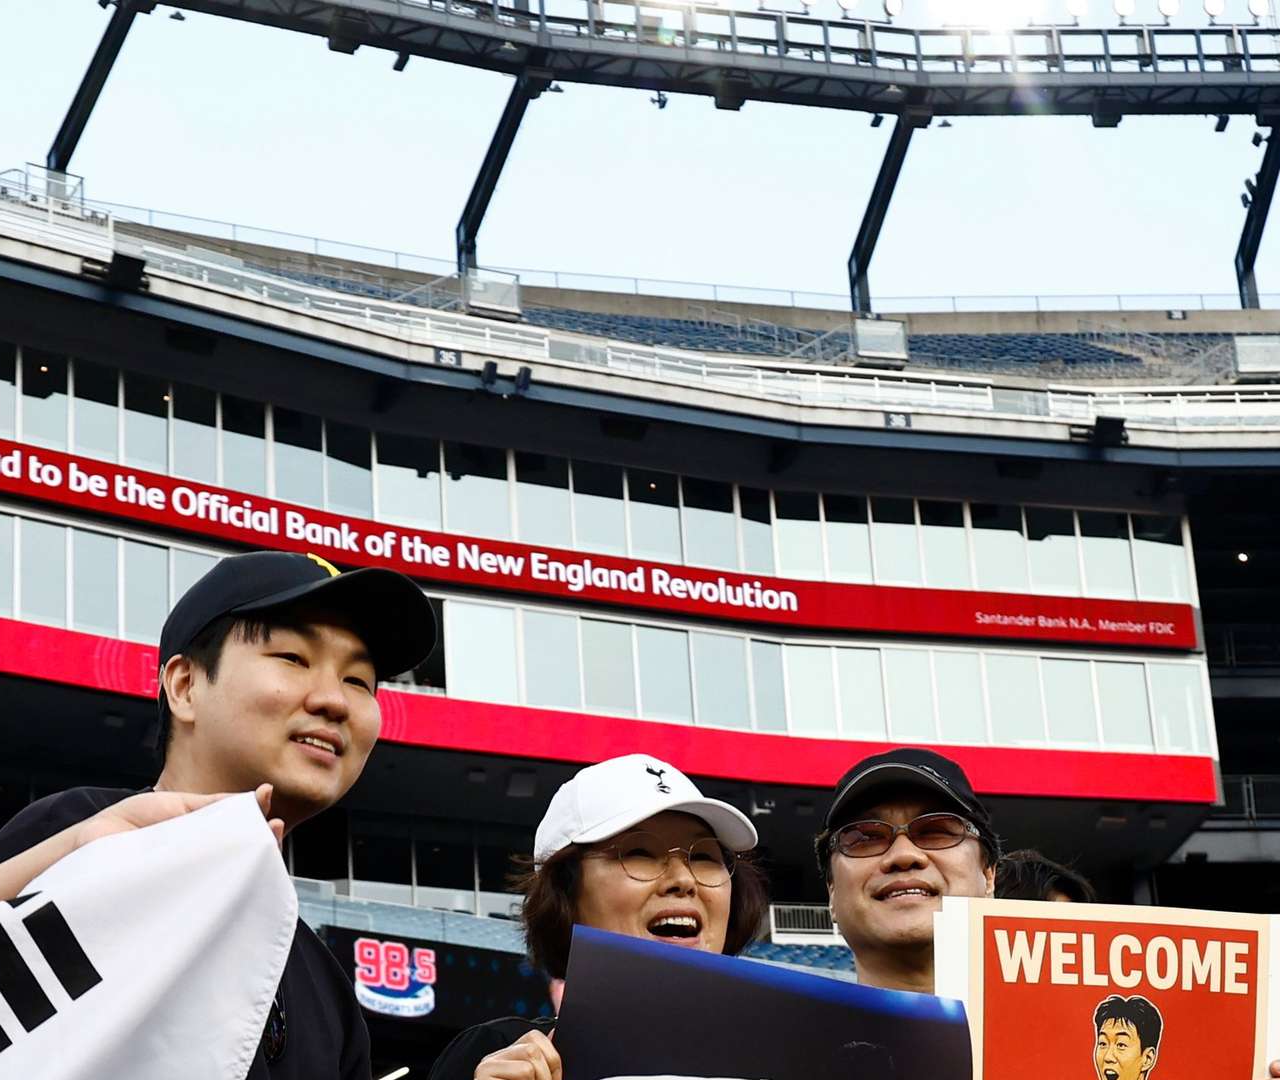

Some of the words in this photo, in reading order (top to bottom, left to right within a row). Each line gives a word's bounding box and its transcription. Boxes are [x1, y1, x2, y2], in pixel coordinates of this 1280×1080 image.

[28, 455, 62, 487] to
[68, 462, 107, 497] be
[115, 474, 166, 510] the
[172, 487, 278, 536] Official
[285, 511, 359, 552] Bank
[365, 531, 397, 558] of
[401, 535, 450, 567] the
[456, 542, 525, 577] New
[531, 553, 645, 593] England
[652, 567, 799, 612] Revolution
[975, 611, 1036, 627] Santander
[1037, 614, 1068, 629] Bank
[1098, 618, 1146, 633] Member
[1148, 621, 1175, 635] FDIC
[993, 929, 1250, 995] WELCOME
